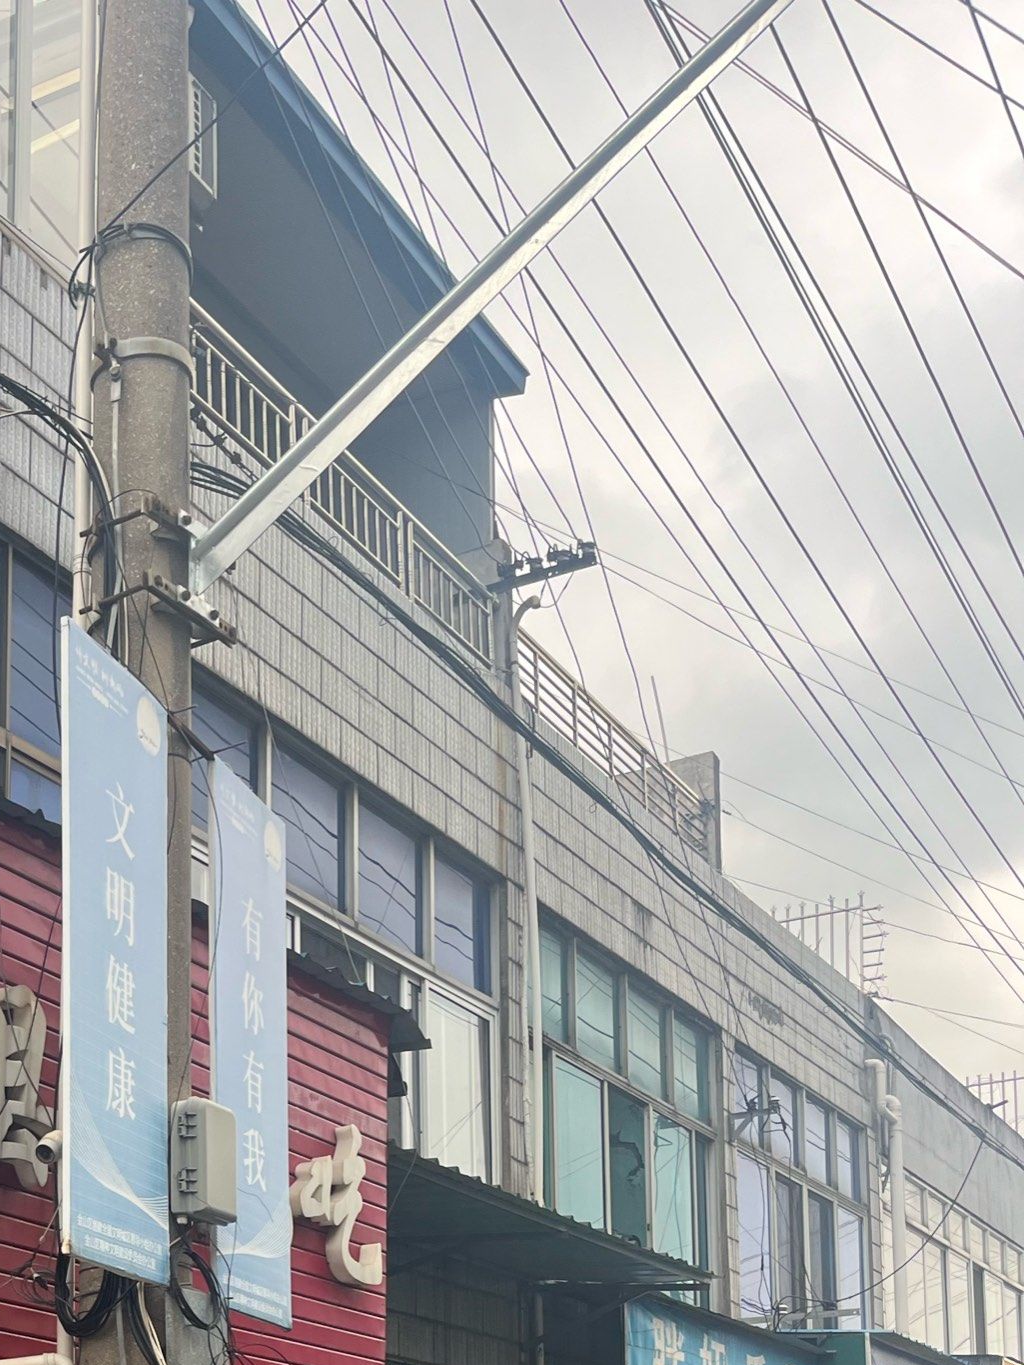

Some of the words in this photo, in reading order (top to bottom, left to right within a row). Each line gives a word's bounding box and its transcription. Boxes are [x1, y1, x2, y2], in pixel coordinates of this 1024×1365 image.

[103, 781, 138, 1122] 文明健康
[239, 896, 268, 1195] 有你有我
